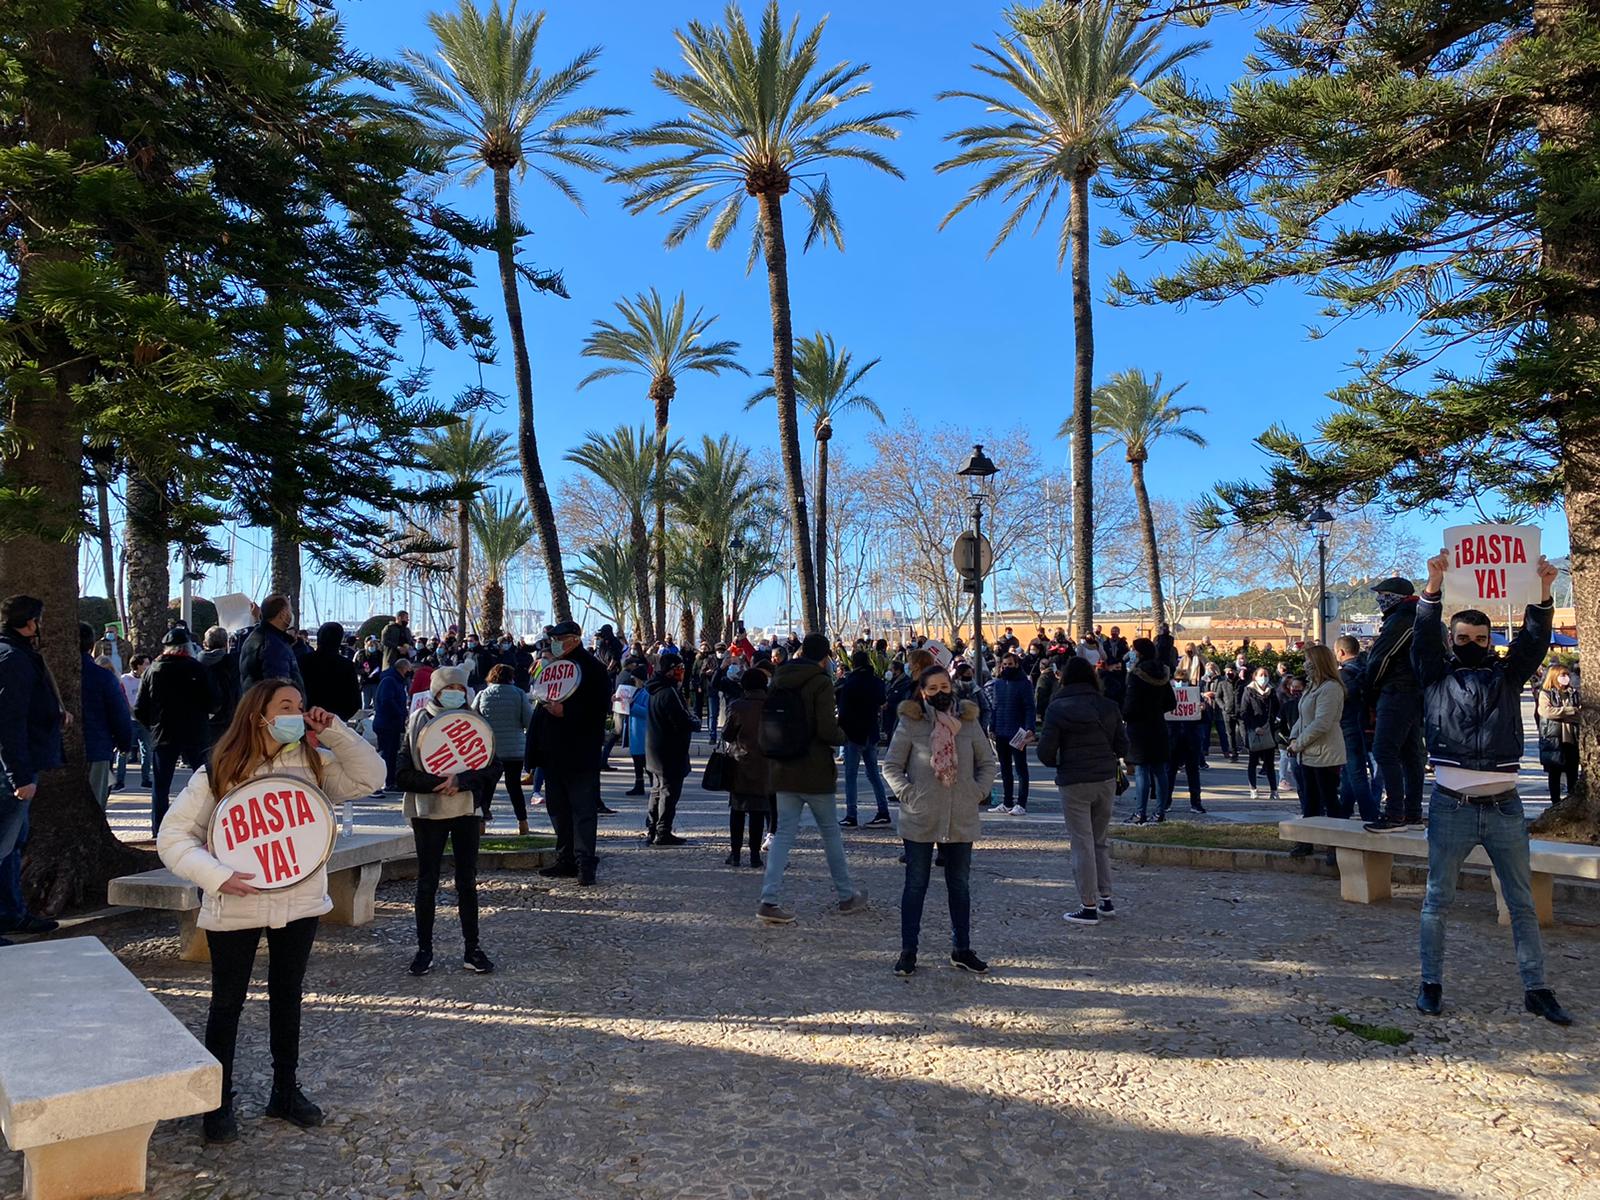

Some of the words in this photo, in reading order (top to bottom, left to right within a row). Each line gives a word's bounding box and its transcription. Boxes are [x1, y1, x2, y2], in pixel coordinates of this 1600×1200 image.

[1455, 534, 1527, 569] ¡BASTA
[1474, 568, 1507, 599] YA!
[539, 663, 575, 685] ¡BASTA
[546, 682, 563, 701] YA!
[1170, 702, 1196, 717] ¡BAST
[425, 743, 458, 776] YA!
[441, 719, 489, 771] ¡BASTA
[221, 790, 316, 851] ¡BASTA
[253, 836, 301, 884] YA!
